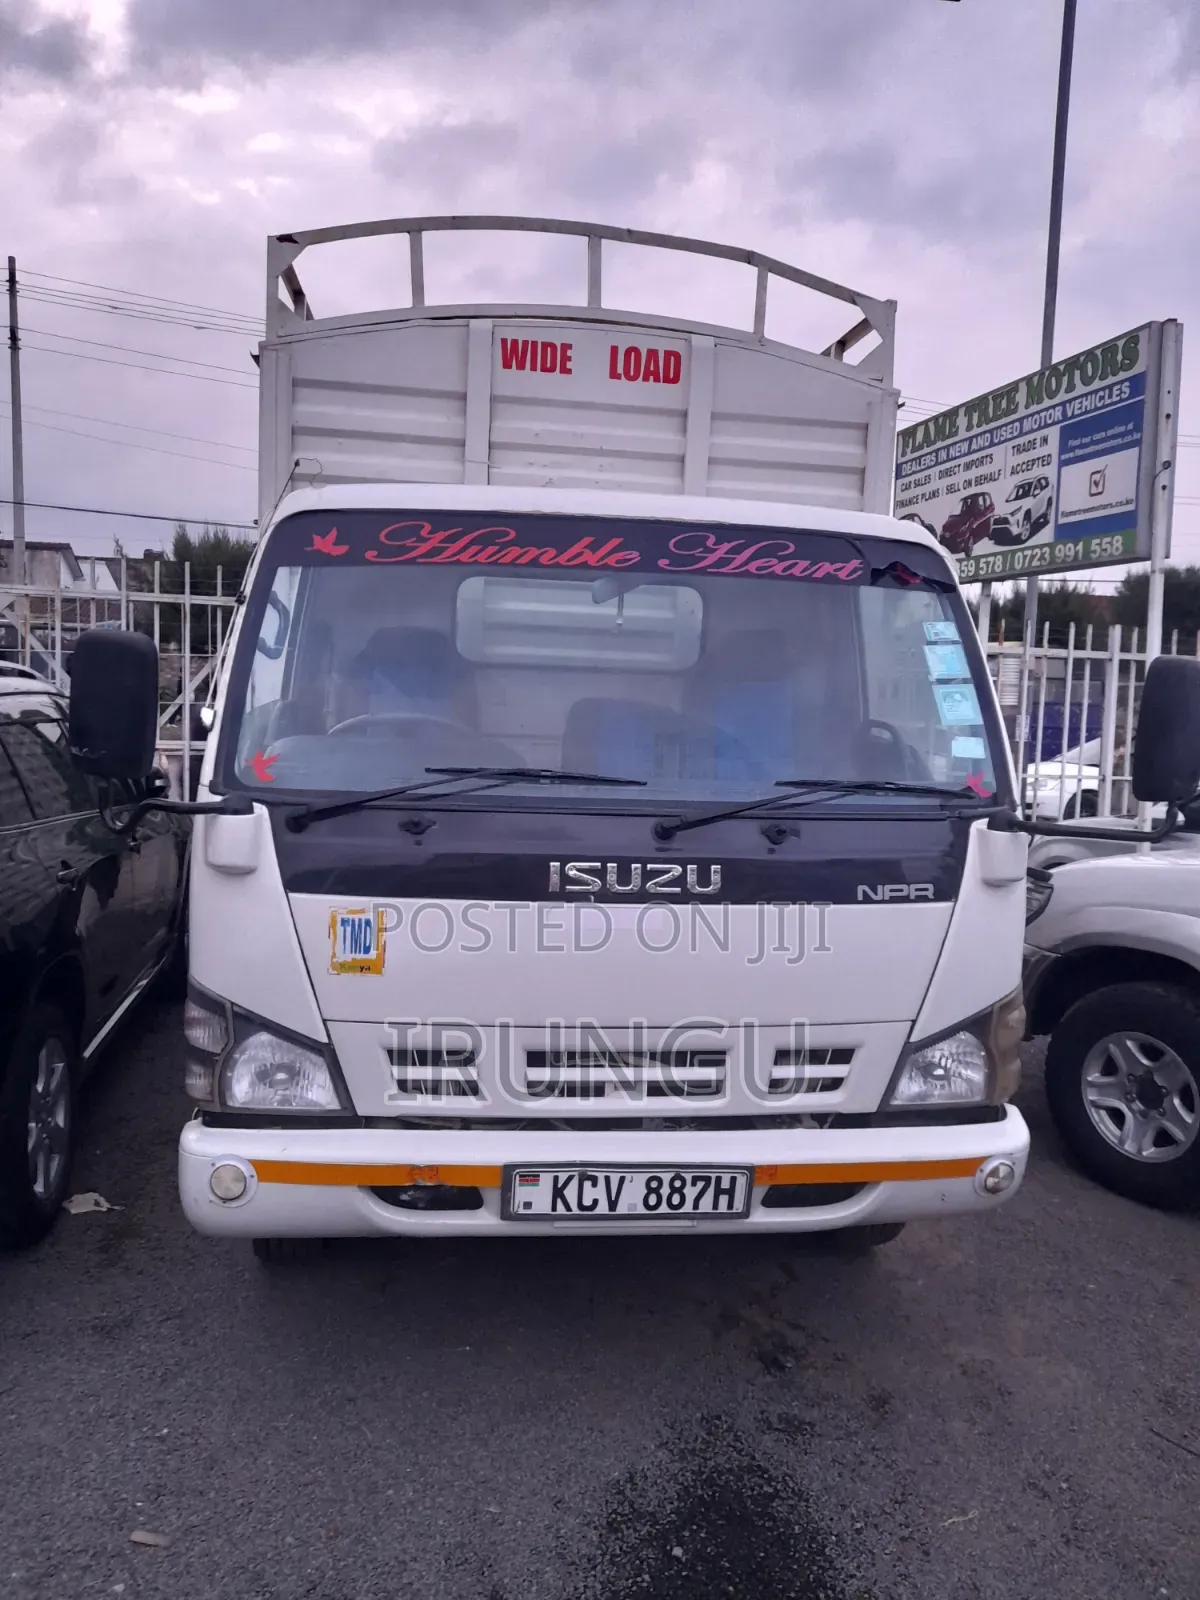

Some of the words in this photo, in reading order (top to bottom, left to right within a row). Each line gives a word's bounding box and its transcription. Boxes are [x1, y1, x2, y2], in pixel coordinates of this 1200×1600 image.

[500, 338, 573, 375] WIDE
[609, 345, 682, 385] LOAD
[901, 408, 959, 458] FLAME
[964, 383, 1019, 432] TREE
[1024, 334, 1140, 410] MOTORS
[901, 454, 936, 475] DEALERS
[938, 450, 948, 462] IN
[949, 441, 969, 457] NEW
[971, 432, 991, 452] AND
[993, 421, 1021, 442] USED
[1022, 406, 1062, 433] MOTOR
[1066, 382, 1130, 417] VEHICLES
[1011, 438, 1037, 456] TRADE
[1039, 434, 1049, 446] IN
[900, 480, 912, 493] CAR
[913, 474, 932, 490] SALES
[938, 464, 961, 481] DIRECT
[962, 453, 994, 472] IMPORTS
[1010, 453, 1052, 477] ACCEPTED
[895, 494, 919, 510] FINANCE
[920, 488, 940, 503] PLANS
[945, 481, 961, 495] SELL
[962, 478, 973, 490] ON
[974, 469, 1002, 487] BEHALF
[365, 521, 641, 567] Humble
[657, 532, 864, 580] Heart
[979, 555, 1003, 575] 578
[1014, 547, 1050, 570] 0723
[1055, 540, 1084, 562] 991
[1090, 535, 1123, 559] 558
[549, 861, 722, 894] ISUZU
[857, 883, 935, 901] NPR
[551, 1174, 626, 1212] KCV
[642, 1174, 738, 1211] 887H
